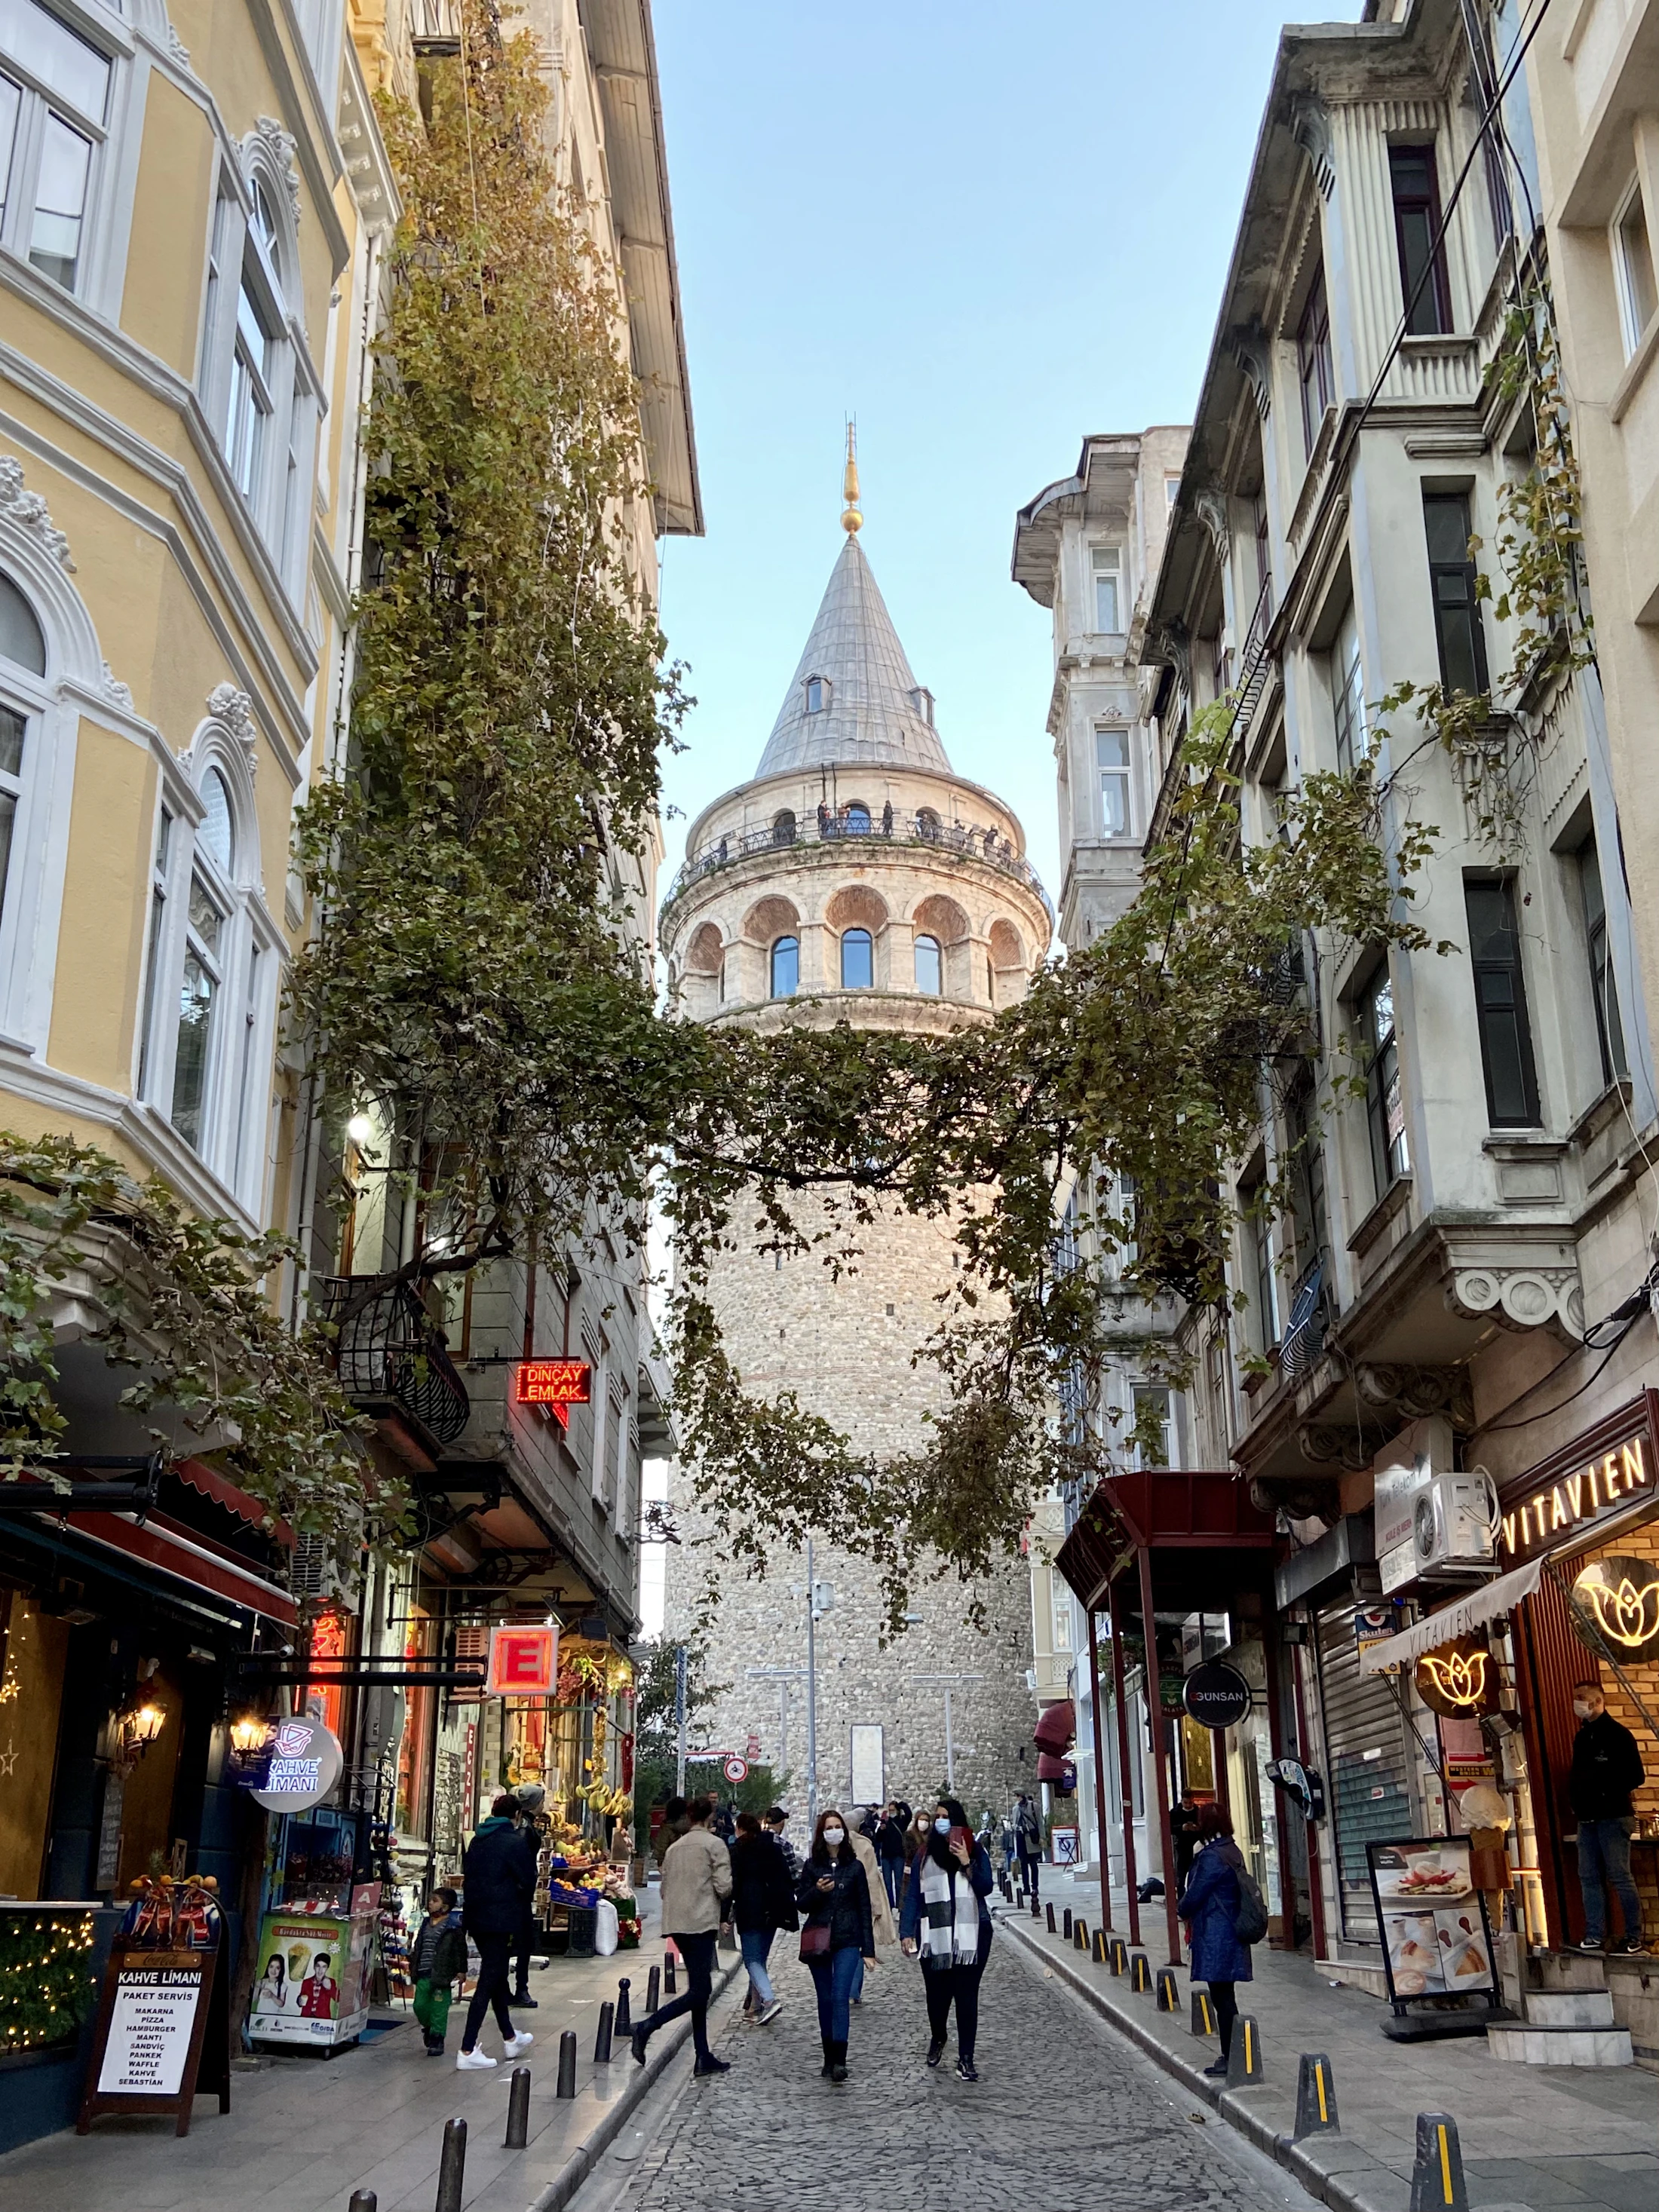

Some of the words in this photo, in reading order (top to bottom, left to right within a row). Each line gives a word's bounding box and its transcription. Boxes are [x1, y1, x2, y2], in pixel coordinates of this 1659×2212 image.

[527, 1368, 582, 1385] DİNÇAY
[528, 1385, 581, 1399] EMLAK
[1502, 1438, 1645, 1555] VITAVIEN
[1409, 1605, 1473, 1655] VITAVIEN
[506, 1640, 540, 1682] E
[1195, 1692, 1243, 1702] GÜNSAN
[118, 1971, 158, 1984] KAHVE
[161, 1969, 202, 1984] LİMANI
[123, 1992, 155, 2000] PAKET
[158, 1992, 192, 2001] SERVİS
[130, 2042, 165, 2051] SANDVİÇ
[118, 2078, 163, 2086] SEBASTİAN
